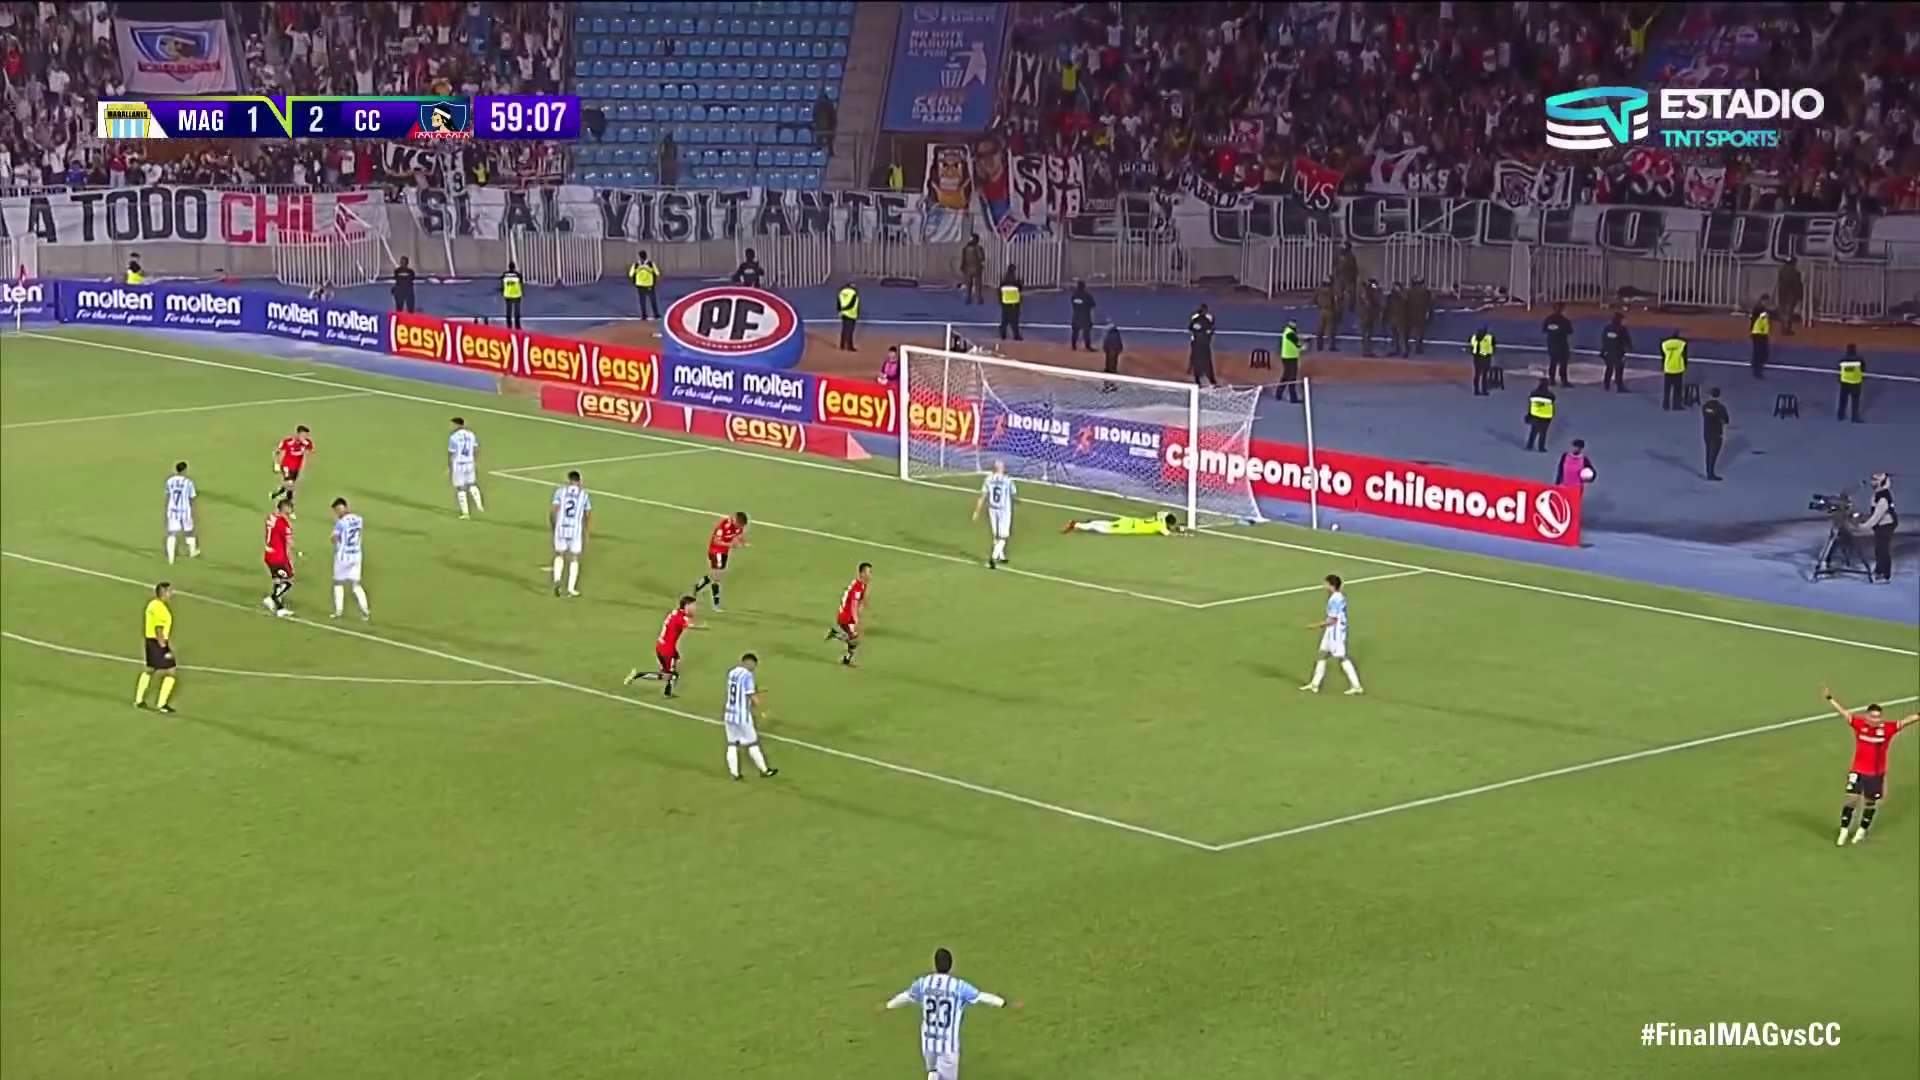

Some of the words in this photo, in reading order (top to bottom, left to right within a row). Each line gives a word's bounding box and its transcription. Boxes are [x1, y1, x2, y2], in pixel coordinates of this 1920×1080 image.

[28, 197, 57, 243] A
[71, 187, 208, 242] TODO
[500, 189, 572, 237] AL
[598, 187, 916, 243] VISITANTE
[77, 289, 153, 310] molten
[166, 292, 241, 315] molten
[76, 309, 91, 319] For
[92, 310, 107, 320] the
[108, 311, 127, 320] real
[127, 313, 153, 324] game
[164, 313, 179, 322] For
[180, 314, 195, 323] the
[196, 315, 215, 324] real
[215, 317, 241, 328] game
[267, 302, 319, 325] molten
[326, 310, 379, 333] molten
[698, 299, 764, 340] PF
[674, 364, 734, 390] molten
[743, 373, 803, 399] molten
[672, 385, 685, 396] For
[685, 387, 696, 397] the
[696, 390, 714, 400] real
[712, 394, 733, 405] game
[741, 394, 753, 405] For
[753, 395, 765, 407] the
[766, 399, 783, 409] real
[781, 403, 802, 414] game
[1008, 413, 1071, 436] IRONADE
[1094, 426, 1161, 448] IRONADE
[993, 486, 1002, 503] 6
[1166, 443, 1352, 497] campeonato
[1366, 471, 1526, 523] chileno.cl
[173, 489, 182, 507] 7
[565, 500, 575, 518] 2
[729, 683, 737, 706] 9
[926, 998, 952, 1029] 23
